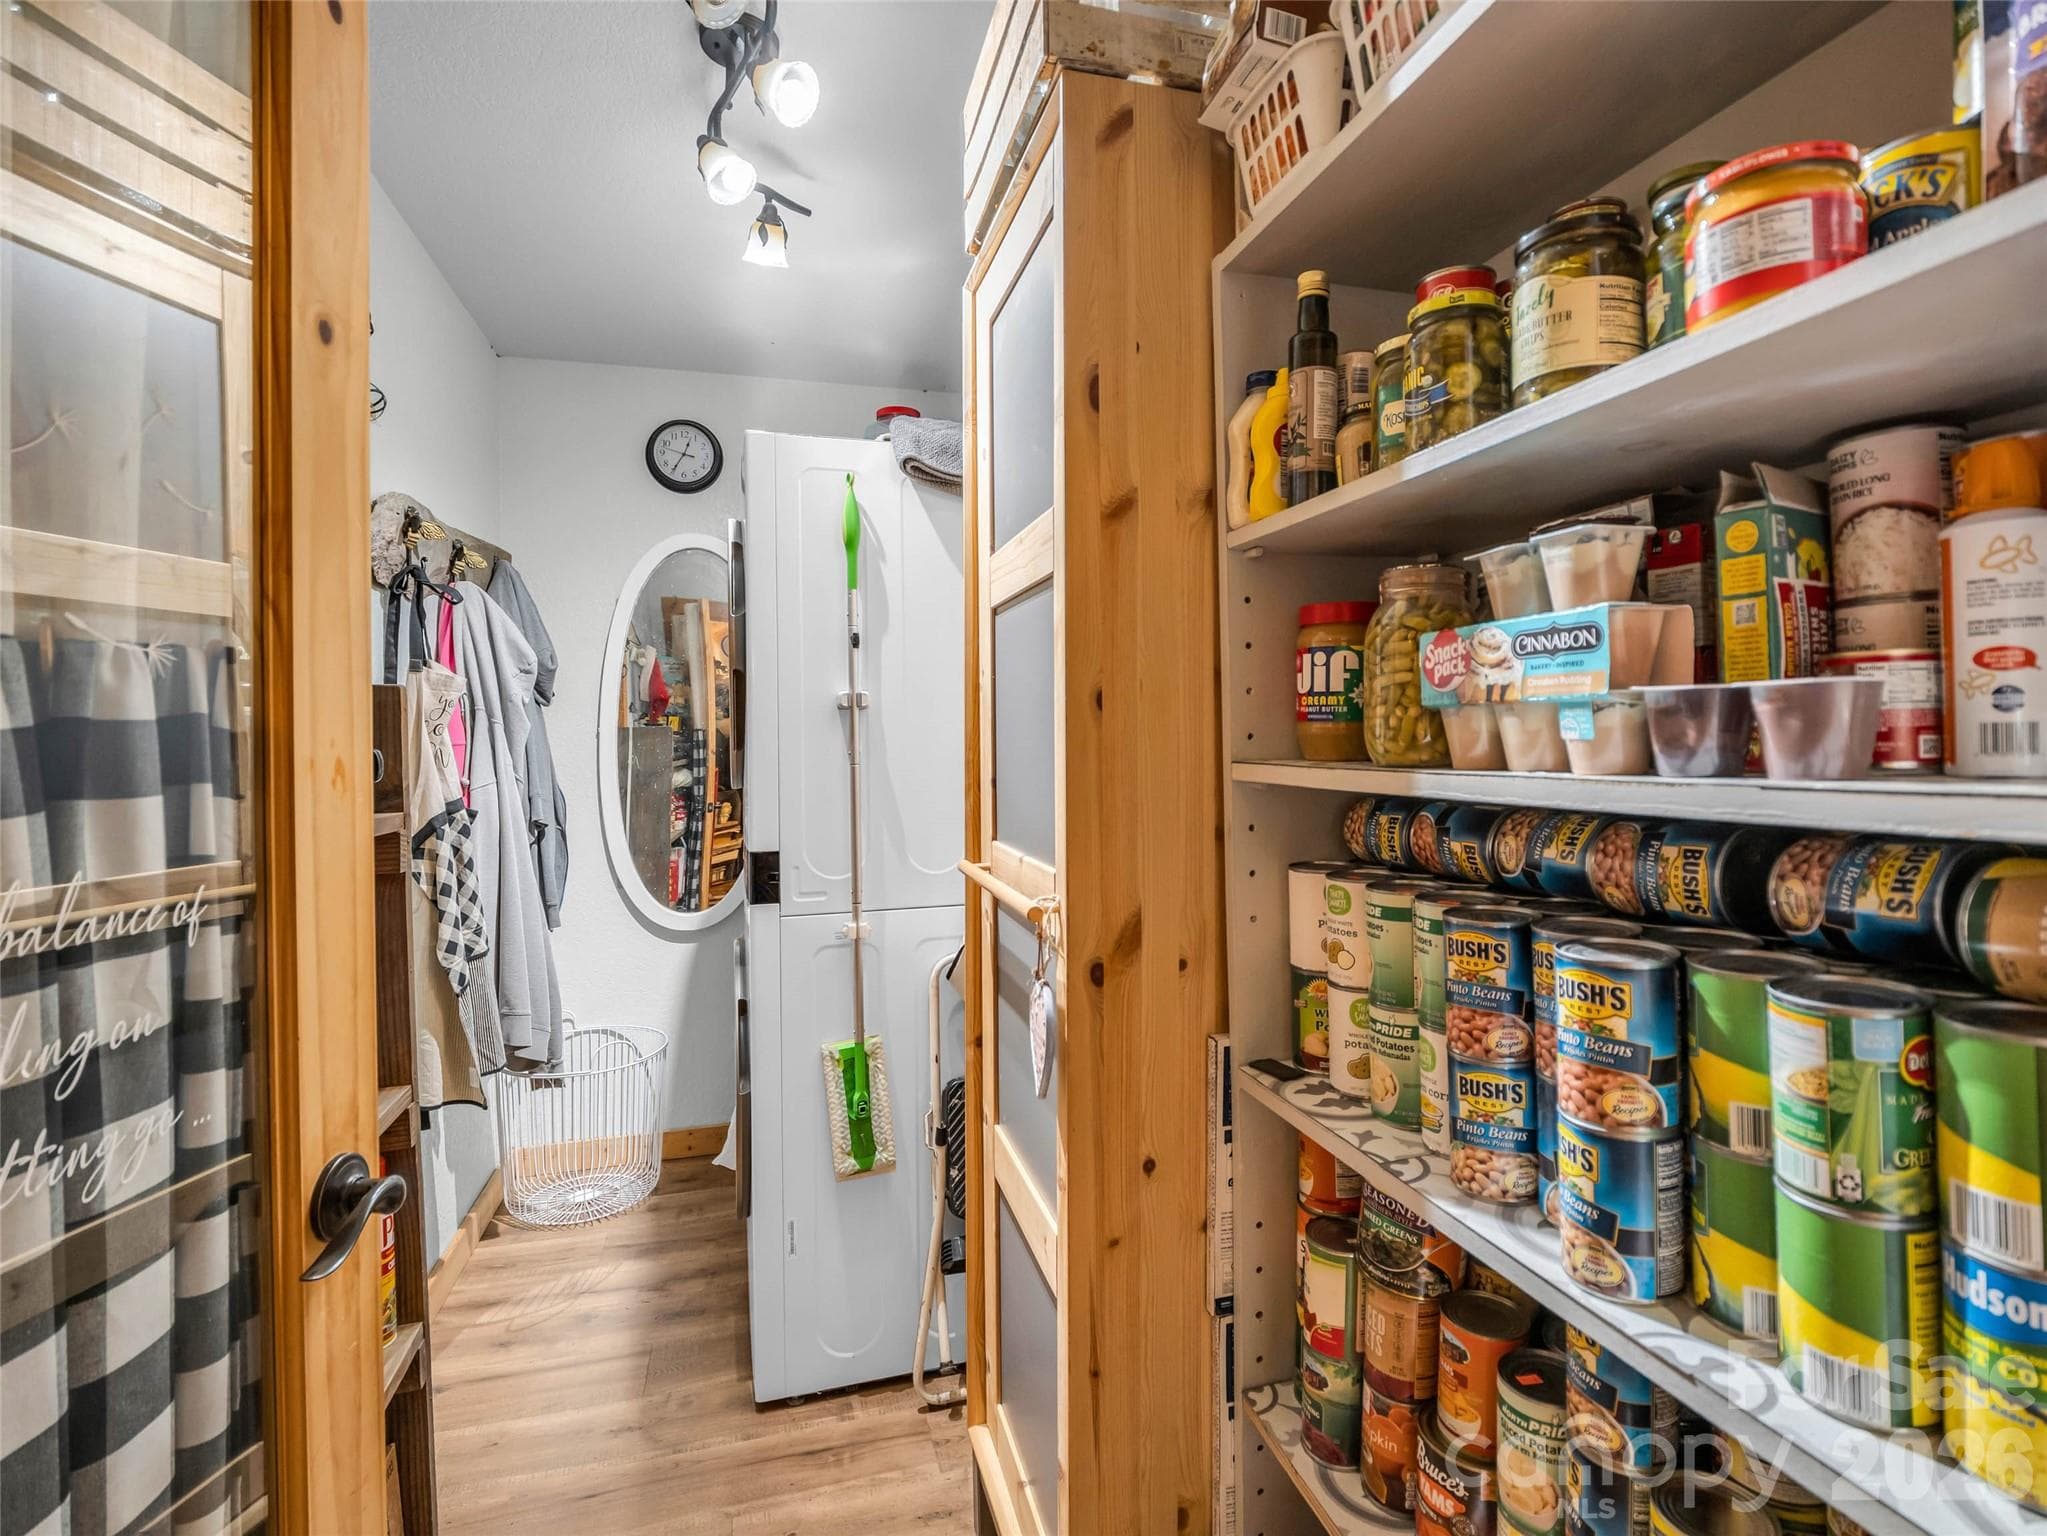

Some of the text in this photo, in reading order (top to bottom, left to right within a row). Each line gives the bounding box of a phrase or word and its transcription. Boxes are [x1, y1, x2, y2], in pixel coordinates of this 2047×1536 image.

[671, 432, 678, 441] 11
[680, 430, 689, 439] 12
[660, 449, 666, 457] 9
[663, 460, 669, 468] 8
[681, 471, 687, 479] 6
[692, 470, 697, 478] 5
[1516, 627, 1598, 654] CINNABON
[1819, 611, 1829, 652] RAIS
[1425, 638, 1468, 669] Snack
[1297, 650, 1360, 695] Jif
[1433, 659, 1467, 684] pack
[1301, 696, 1345, 706] CREAMY
[1387, 815, 1402, 863] BUSH'S
[1647, 840, 1659, 872] Pinto
[1682, 848, 1708, 917] BUSH'S
[1840, 866, 1861, 914] Beans
[172, 884, 210, 948] of
[1447, 936, 1507, 964] BUSH'S
[1460, 959, 1487, 969] BEST
[1447, 980, 1513, 1002] Pinto Beans
[1558, 975, 1627, 1012] BUSH'S
[1571, 1004, 1602, 1016] BEST
[110, 1011, 171, 1052] on
[1376, 1022, 1413, 1039] PRIDE
[1558, 1027, 1634, 1058] Pinto Beans
[1344, 1039, 1370, 1052] pota
[1376, 1037, 1416, 1054] Potatoes
[1495, 1040, 1524, 1050] Recipes
[1459, 1075, 1523, 1104] BUSH'S
[1474, 1100, 1505, 1109] BEST
[1612, 1104, 1648, 1115] Recipes
[1457, 1119, 1529, 1142] Pinto Beans
[121, 1106, 185, 1184] go
[1561, 1135, 1595, 1174] SH'S
[1363, 1182, 1429, 1228] SEASONED
[1563, 1187, 1601, 1221] Beans
[1383, 1223, 1418, 1244] GREENS
[1581, 1262, 1614, 1278] Recipes
[1570, 1357, 1602, 1392] Beans
[1369, 1428, 1398, 1455] pkin
[1417, 1435, 1469, 1498] Bruce's
